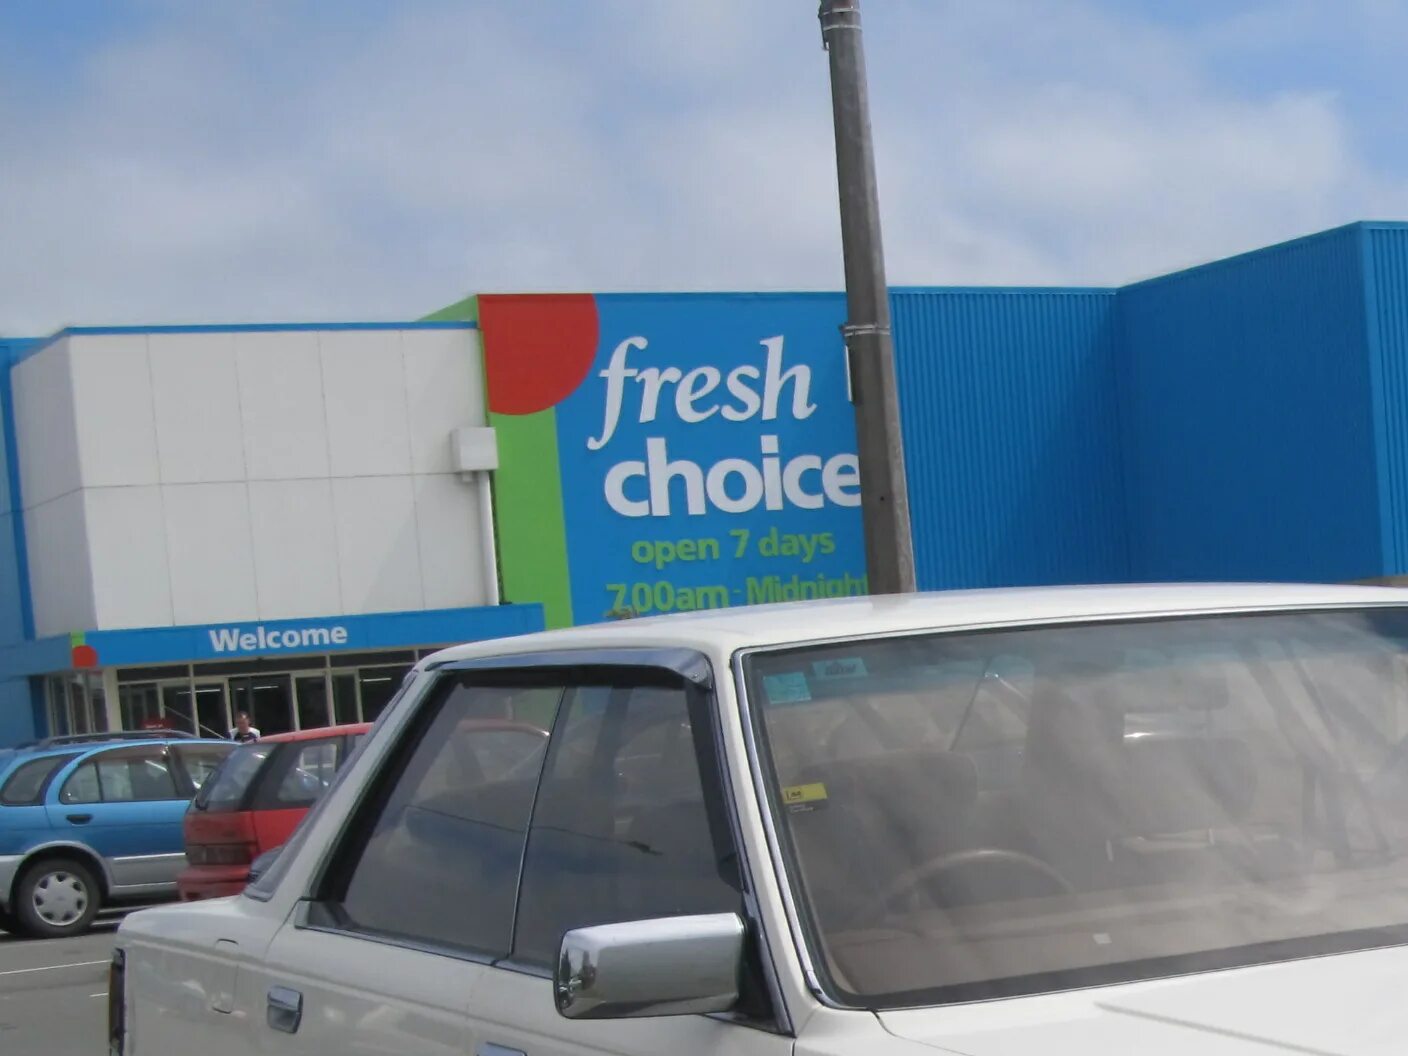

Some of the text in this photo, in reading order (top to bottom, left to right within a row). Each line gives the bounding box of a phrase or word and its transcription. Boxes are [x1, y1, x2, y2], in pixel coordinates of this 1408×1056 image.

[586, 335, 817, 450] fresh
[604, 434, 862, 517] choice
[631, 526, 836, 570] open 7 days
[208, 625, 348, 652] Welcome
